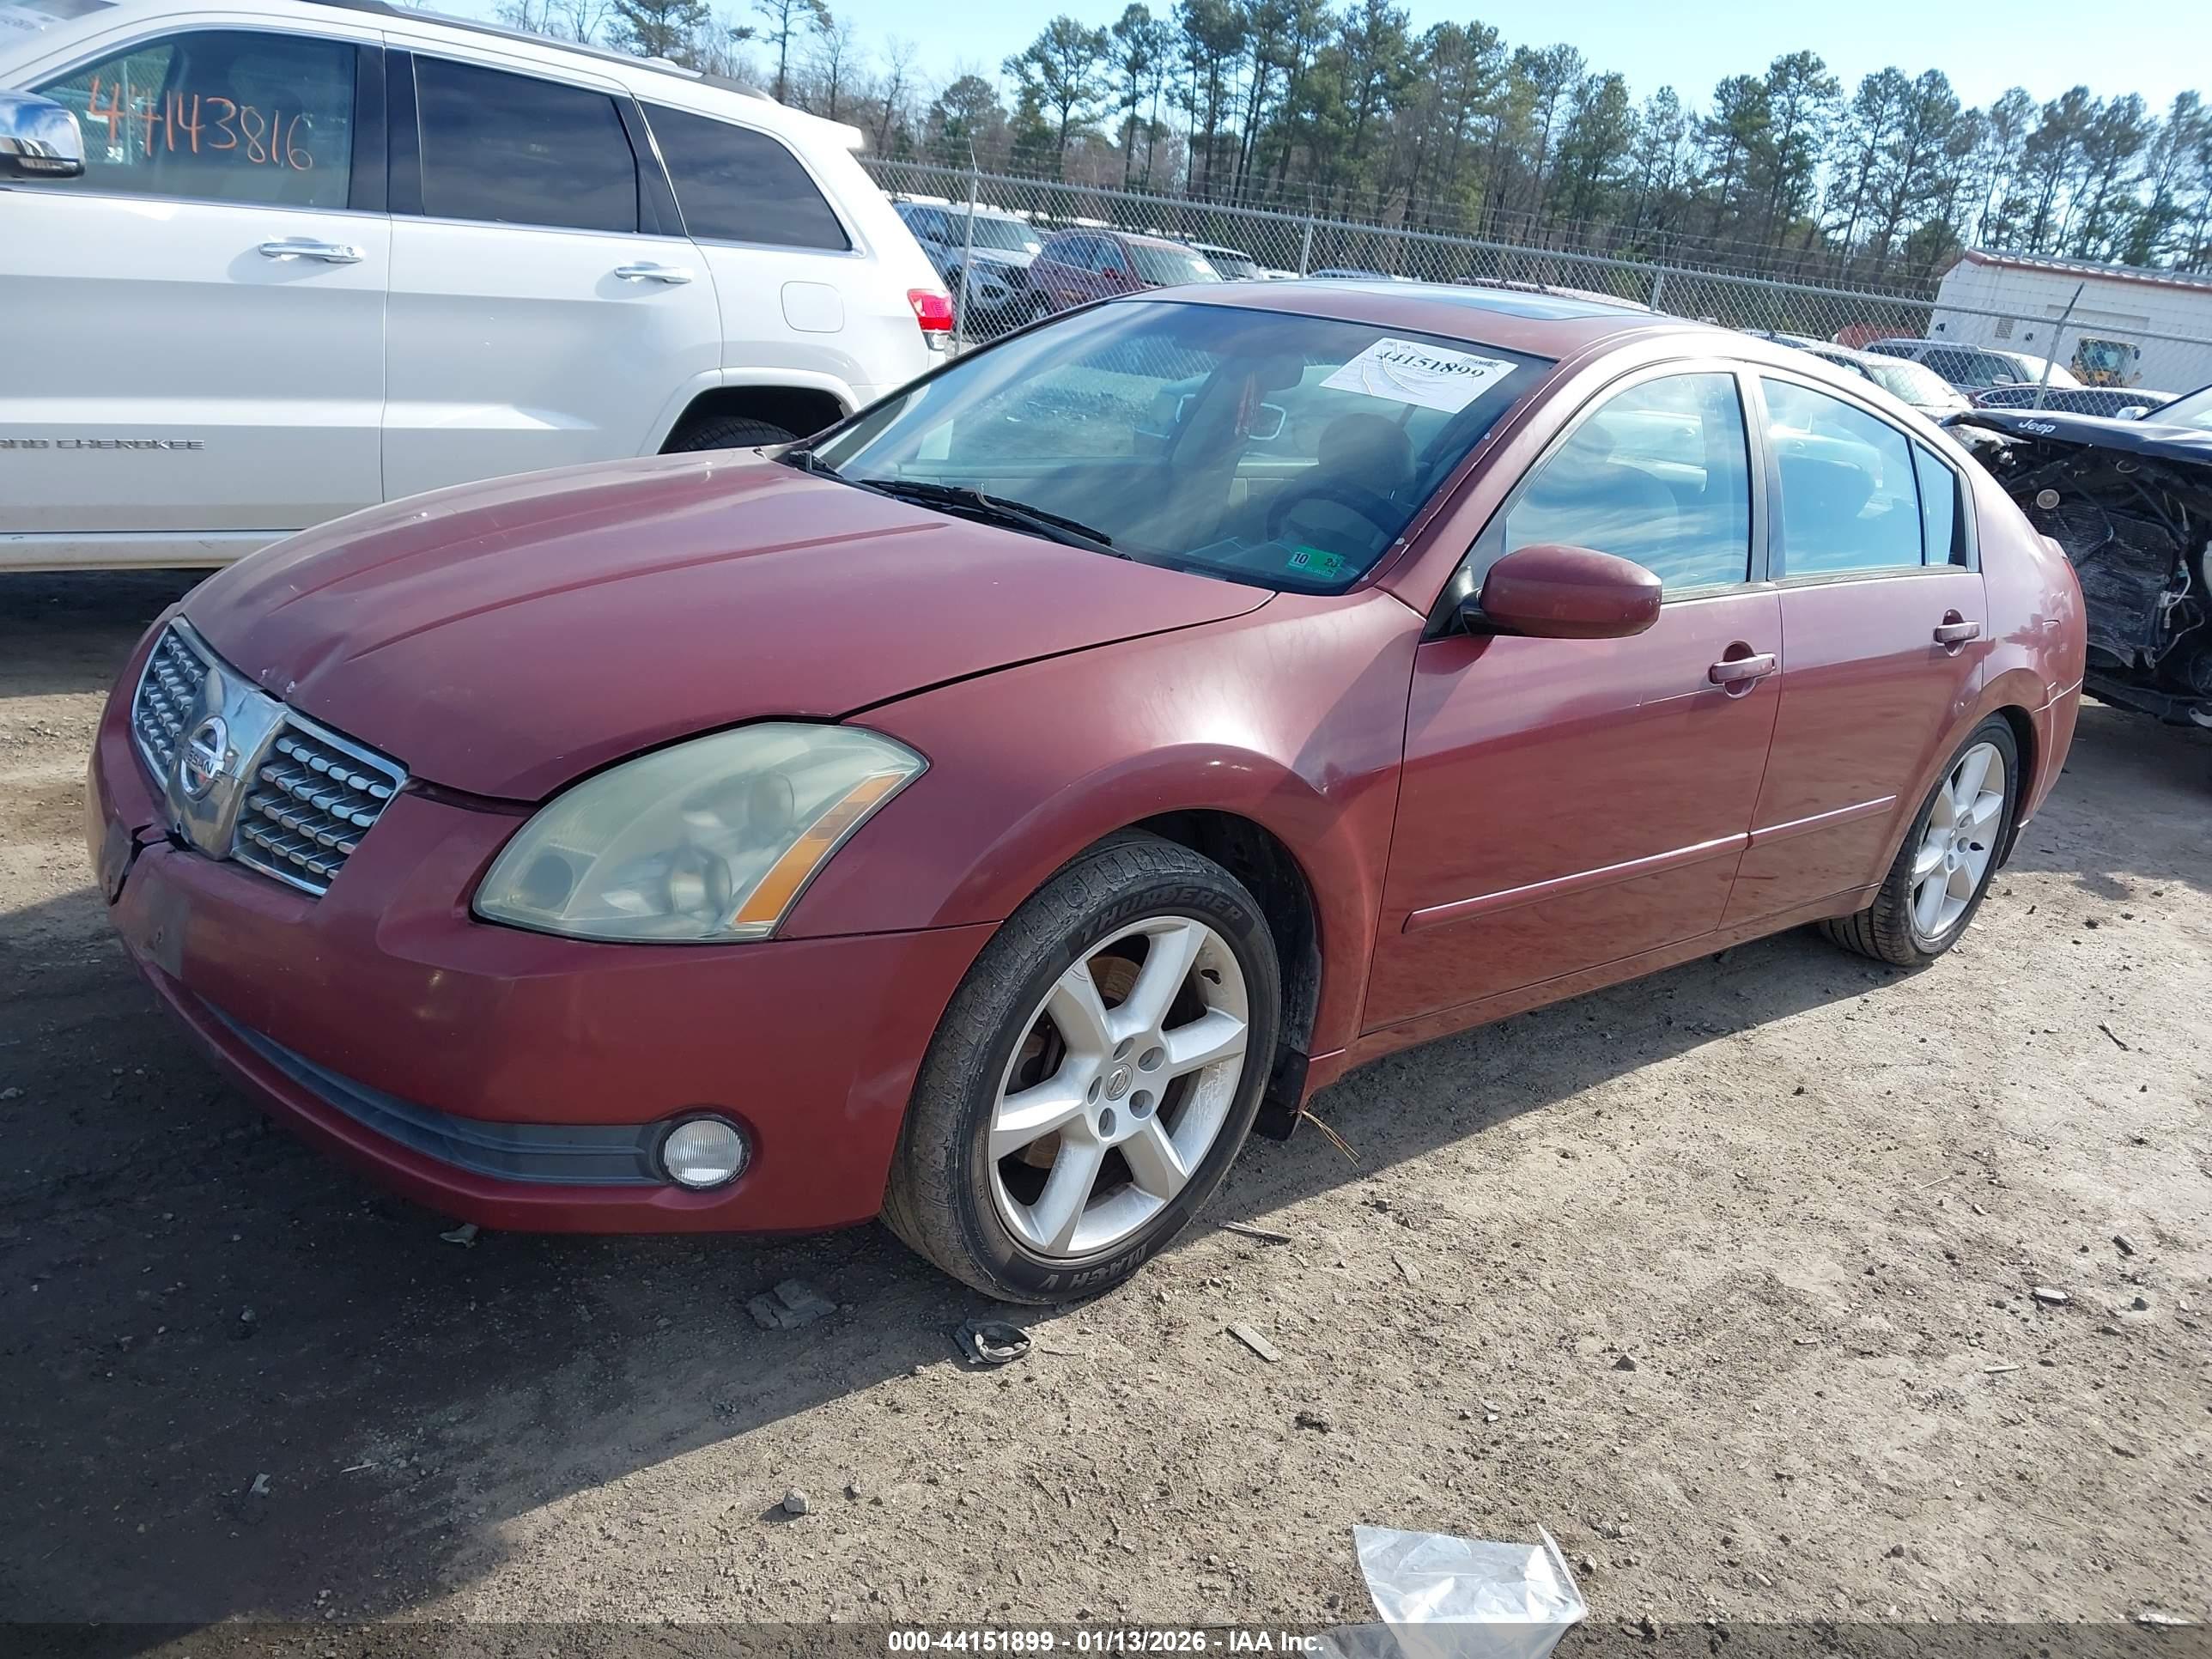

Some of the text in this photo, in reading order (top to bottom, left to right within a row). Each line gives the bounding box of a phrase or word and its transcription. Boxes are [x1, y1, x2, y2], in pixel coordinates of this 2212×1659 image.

[88, 76, 313, 171] 44143816
[2018, 418, 2057, 434] Jeep
[57, 438, 205, 450] CHEROKEE
[1293, 553, 1310, 564] 10
[1081, 886, 1244, 943] THUNDERER
[1068, 1243, 1149, 1289] MACH
